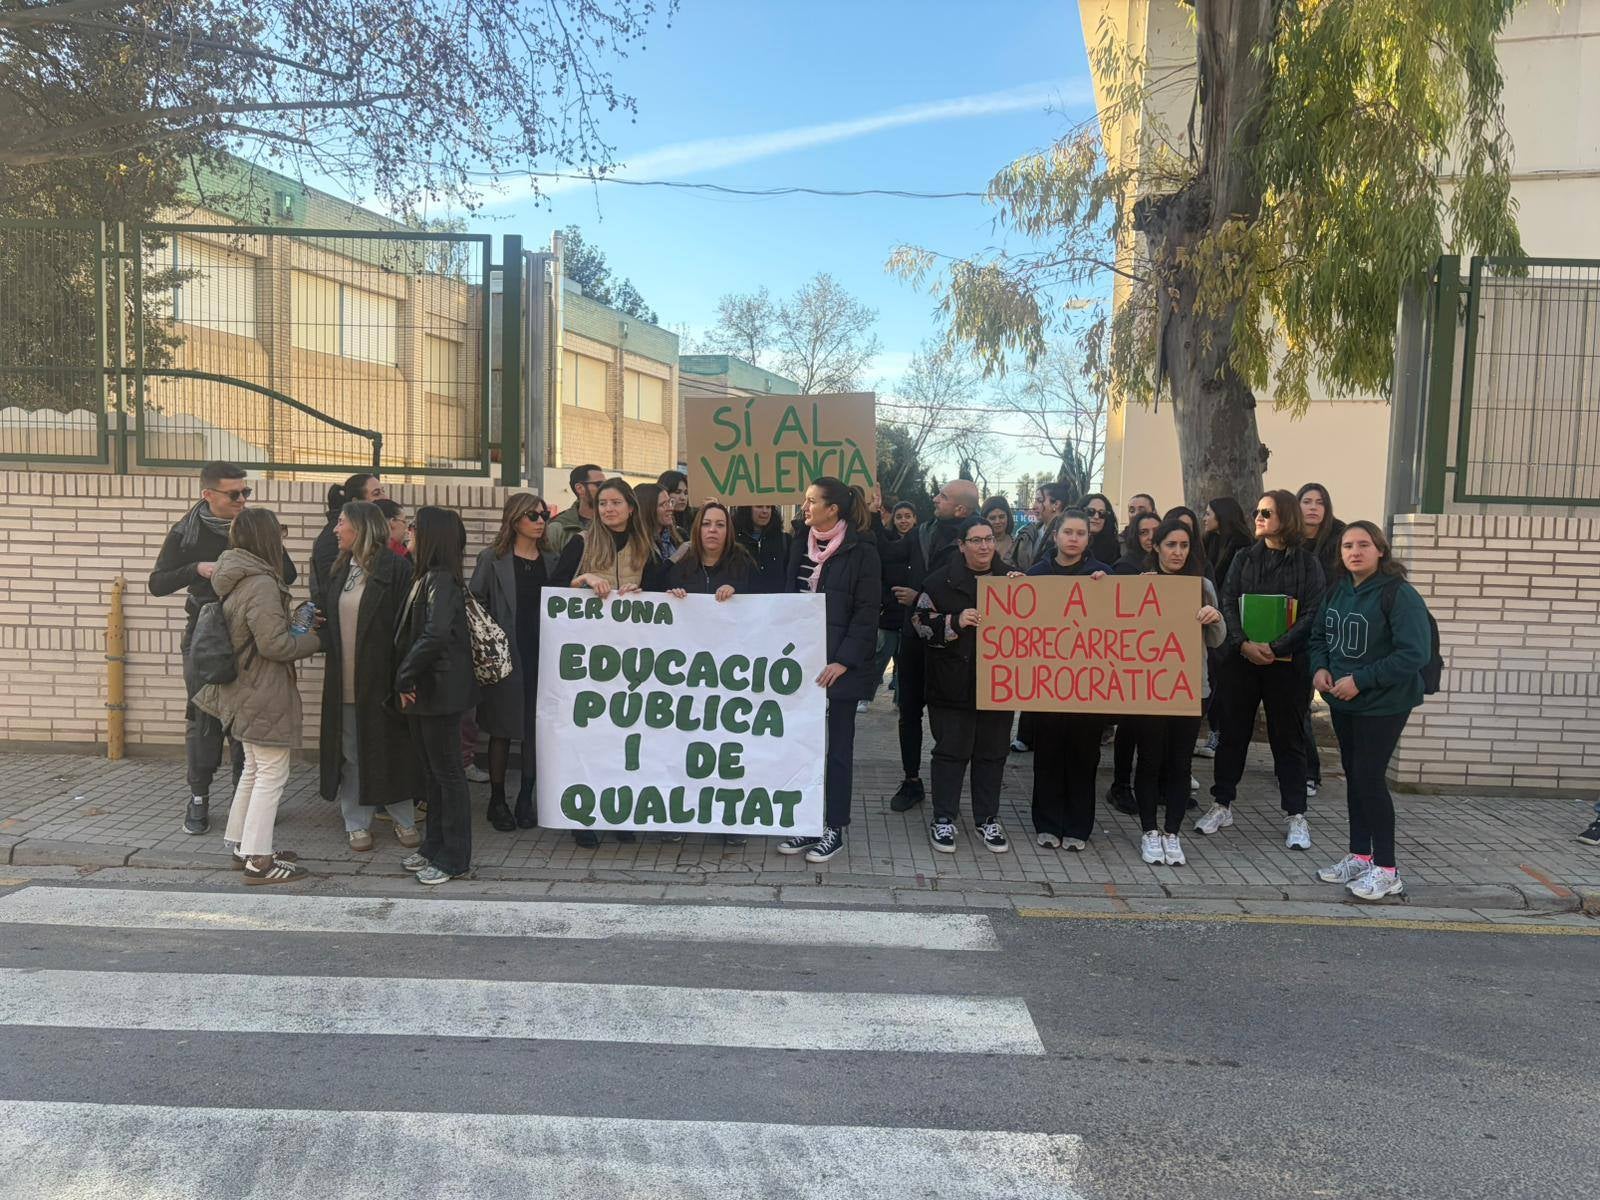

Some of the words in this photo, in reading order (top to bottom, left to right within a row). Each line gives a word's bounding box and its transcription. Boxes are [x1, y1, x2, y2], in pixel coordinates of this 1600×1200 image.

[713, 399, 756, 452] SÍ
[772, 402, 844, 447] AL
[700, 437, 875, 496] VALENCIÀ
[547, 595, 604, 620] PER
[611, 599, 674, 625] UNA
[985, 582, 1038, 620] NO
[1063, 581, 1088, 618] A
[1115, 582, 1163, 619] LA
[982, 619, 1187, 664] SOBRECÀRREGA
[559, 642, 803, 696] EDUCACIÓ
[990, 660, 1195, 704] BUROCRÀTICA
[572, 681, 785, 738] PÚBLICA
[624, 733, 642, 771] I
[685, 741, 745, 780] DE
[560, 783, 803, 828] QUALITAT
